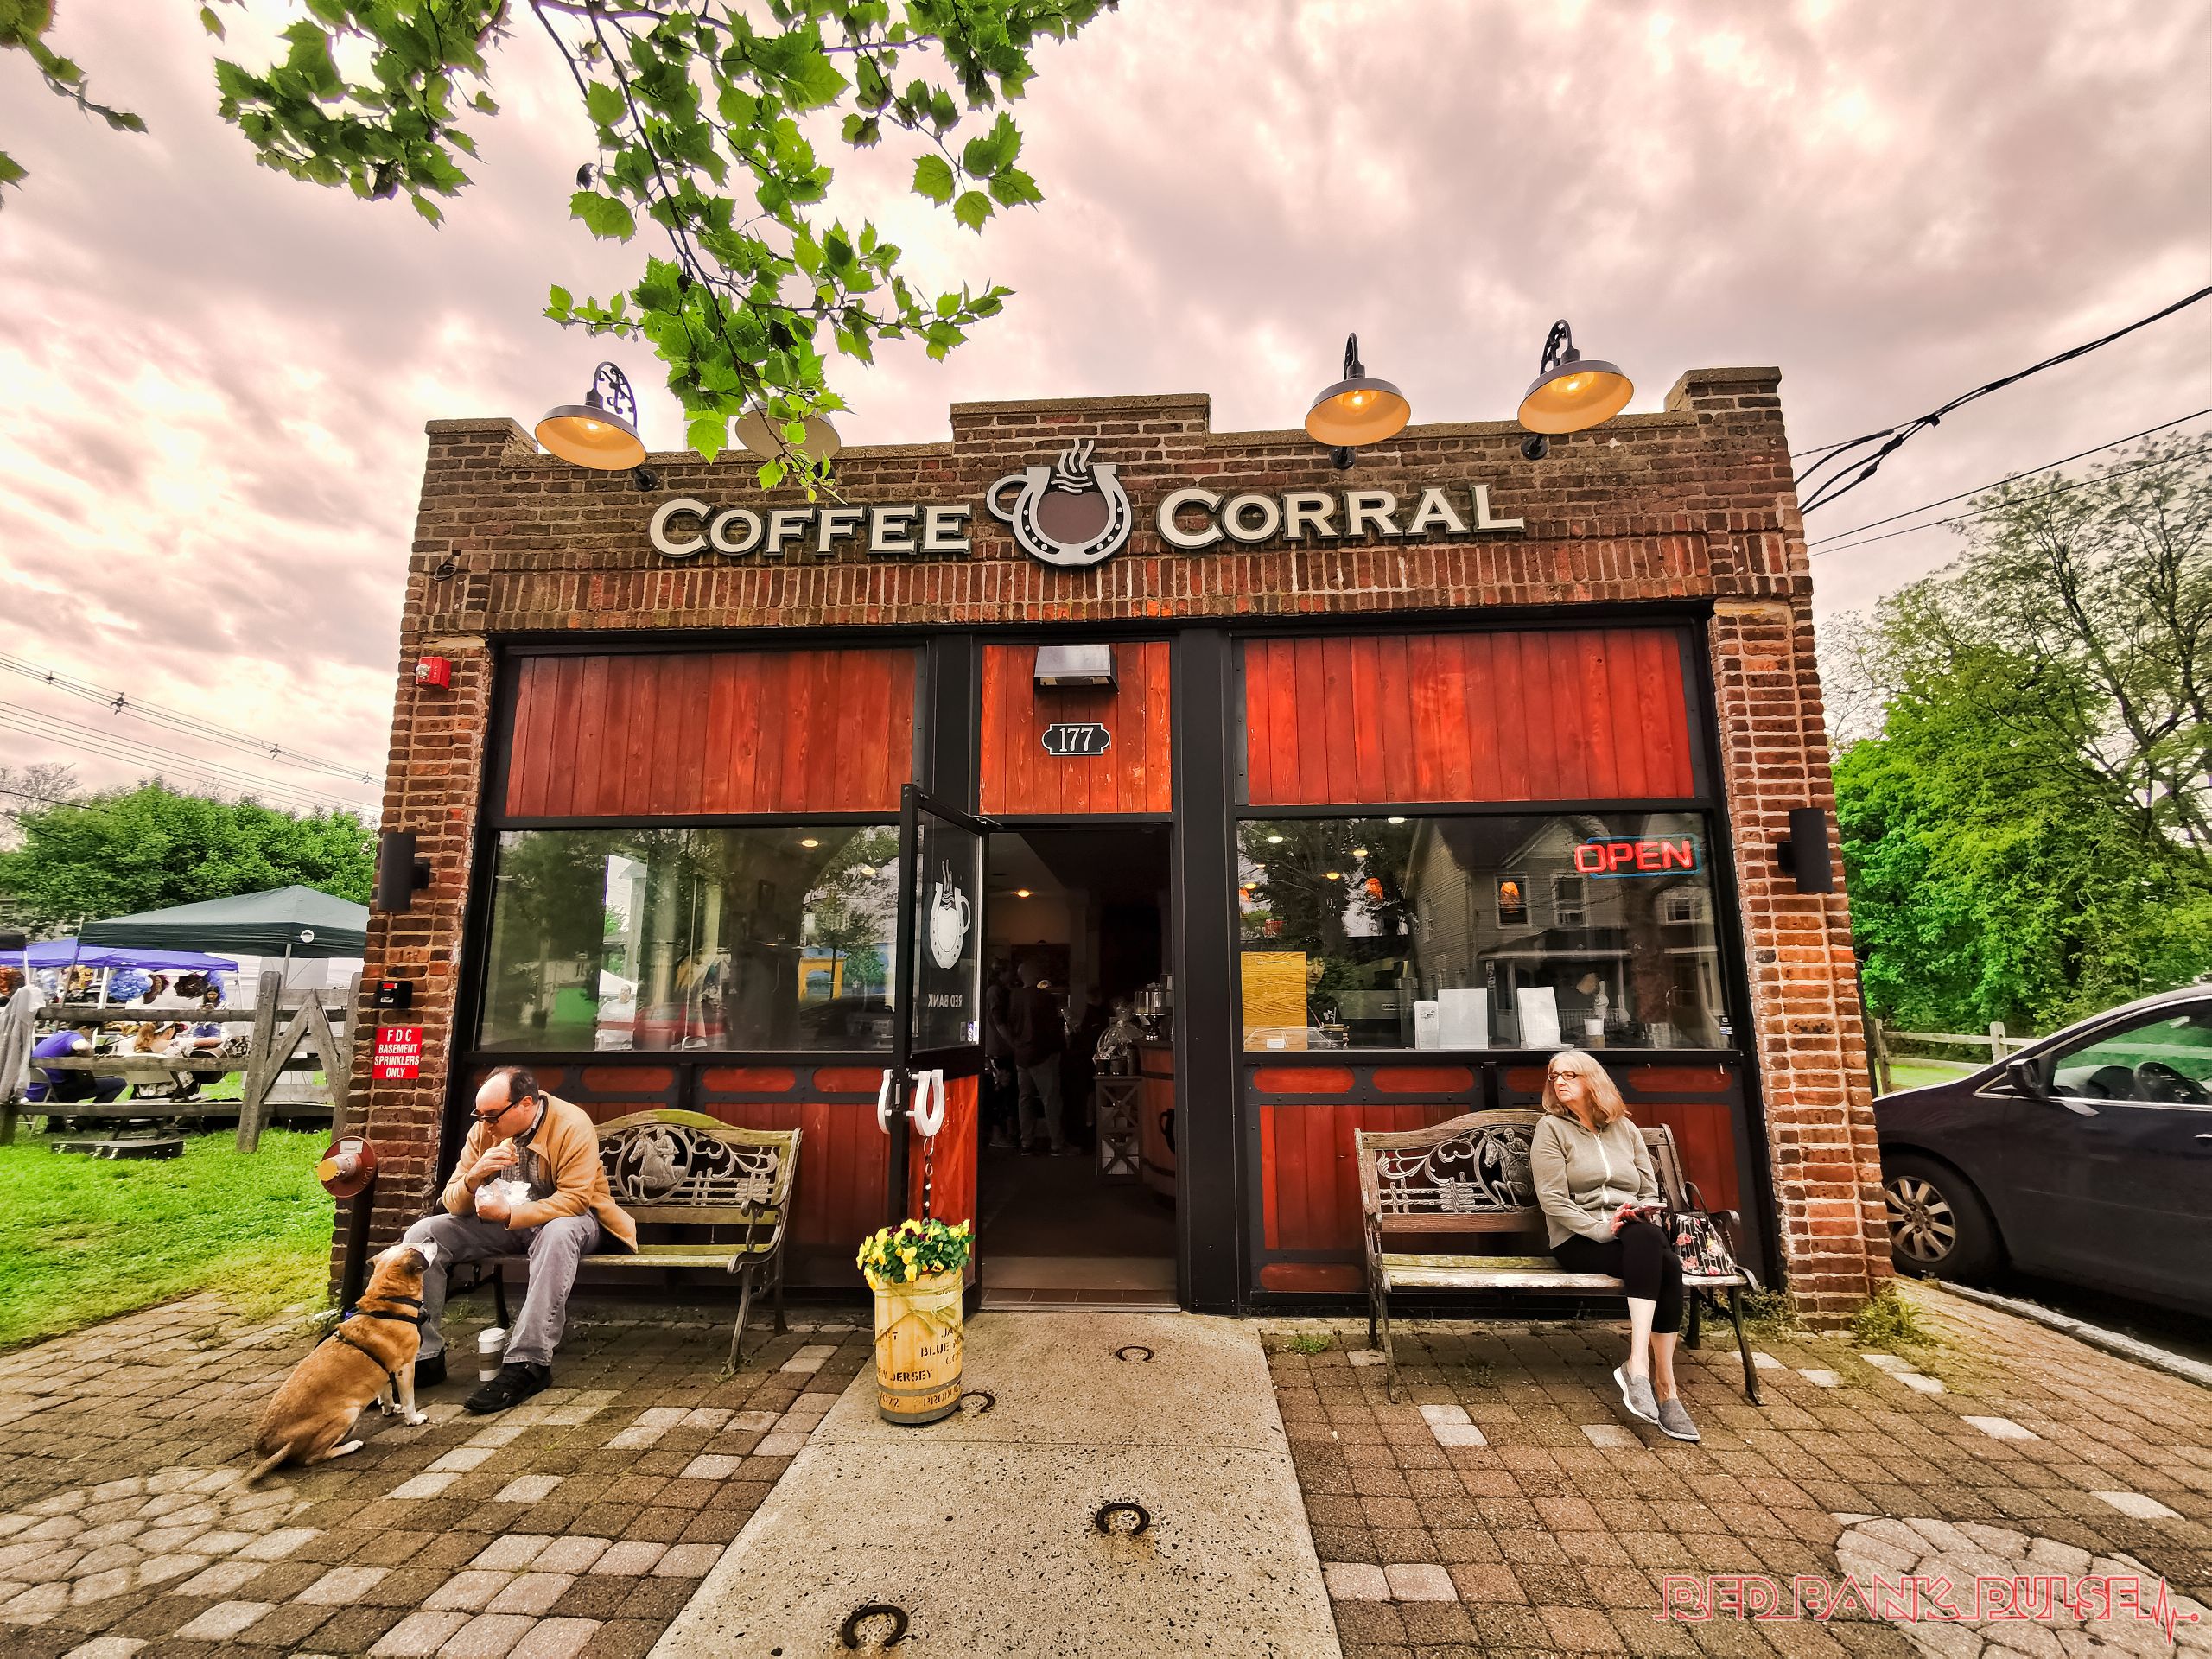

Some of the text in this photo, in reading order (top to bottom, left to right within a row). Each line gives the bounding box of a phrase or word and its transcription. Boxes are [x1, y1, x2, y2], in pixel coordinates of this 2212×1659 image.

[648, 484, 1526, 557] COFFEE CORRAL
[1059, 727, 1094, 752] 177
[1574, 840, 1694, 873] OPEN
[378, 1044, 418, 1054] BASEMENT
[374, 1055, 420, 1065] SPRINKLERS
[385, 1067, 405, 1077] ONLY
[920, 1342, 950, 1357] BLUE
[890, 1369, 933, 1382] JERSEY
